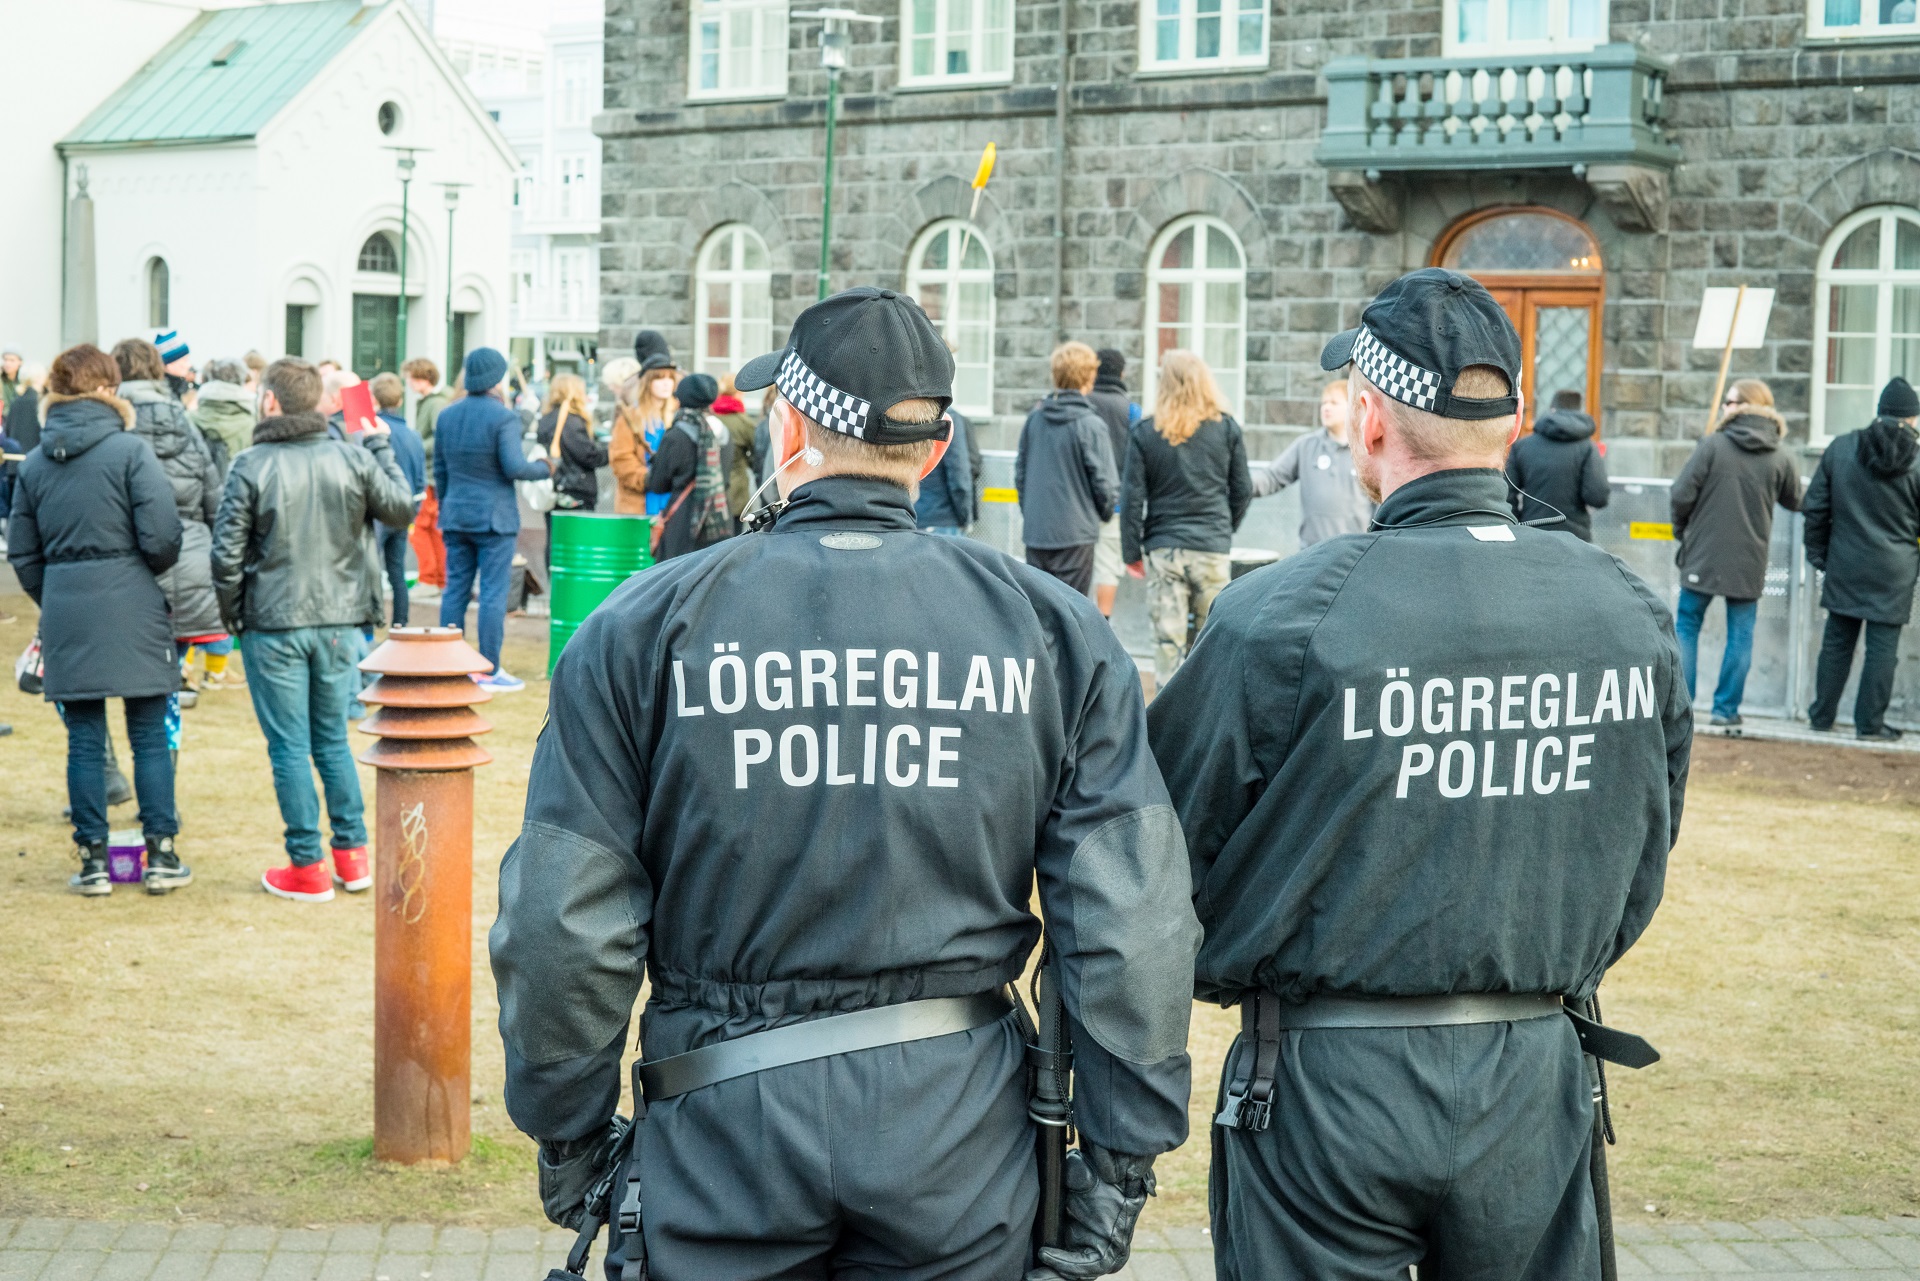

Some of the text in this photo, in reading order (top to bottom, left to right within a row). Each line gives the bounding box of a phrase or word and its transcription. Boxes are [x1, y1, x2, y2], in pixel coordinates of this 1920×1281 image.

[673, 642, 1035, 717] LÖGREGLAN
[1343, 666, 1655, 741] LÖGREGLAN
[733, 724, 962, 789] POLICE
[1396, 734, 1595, 799] POLICE
